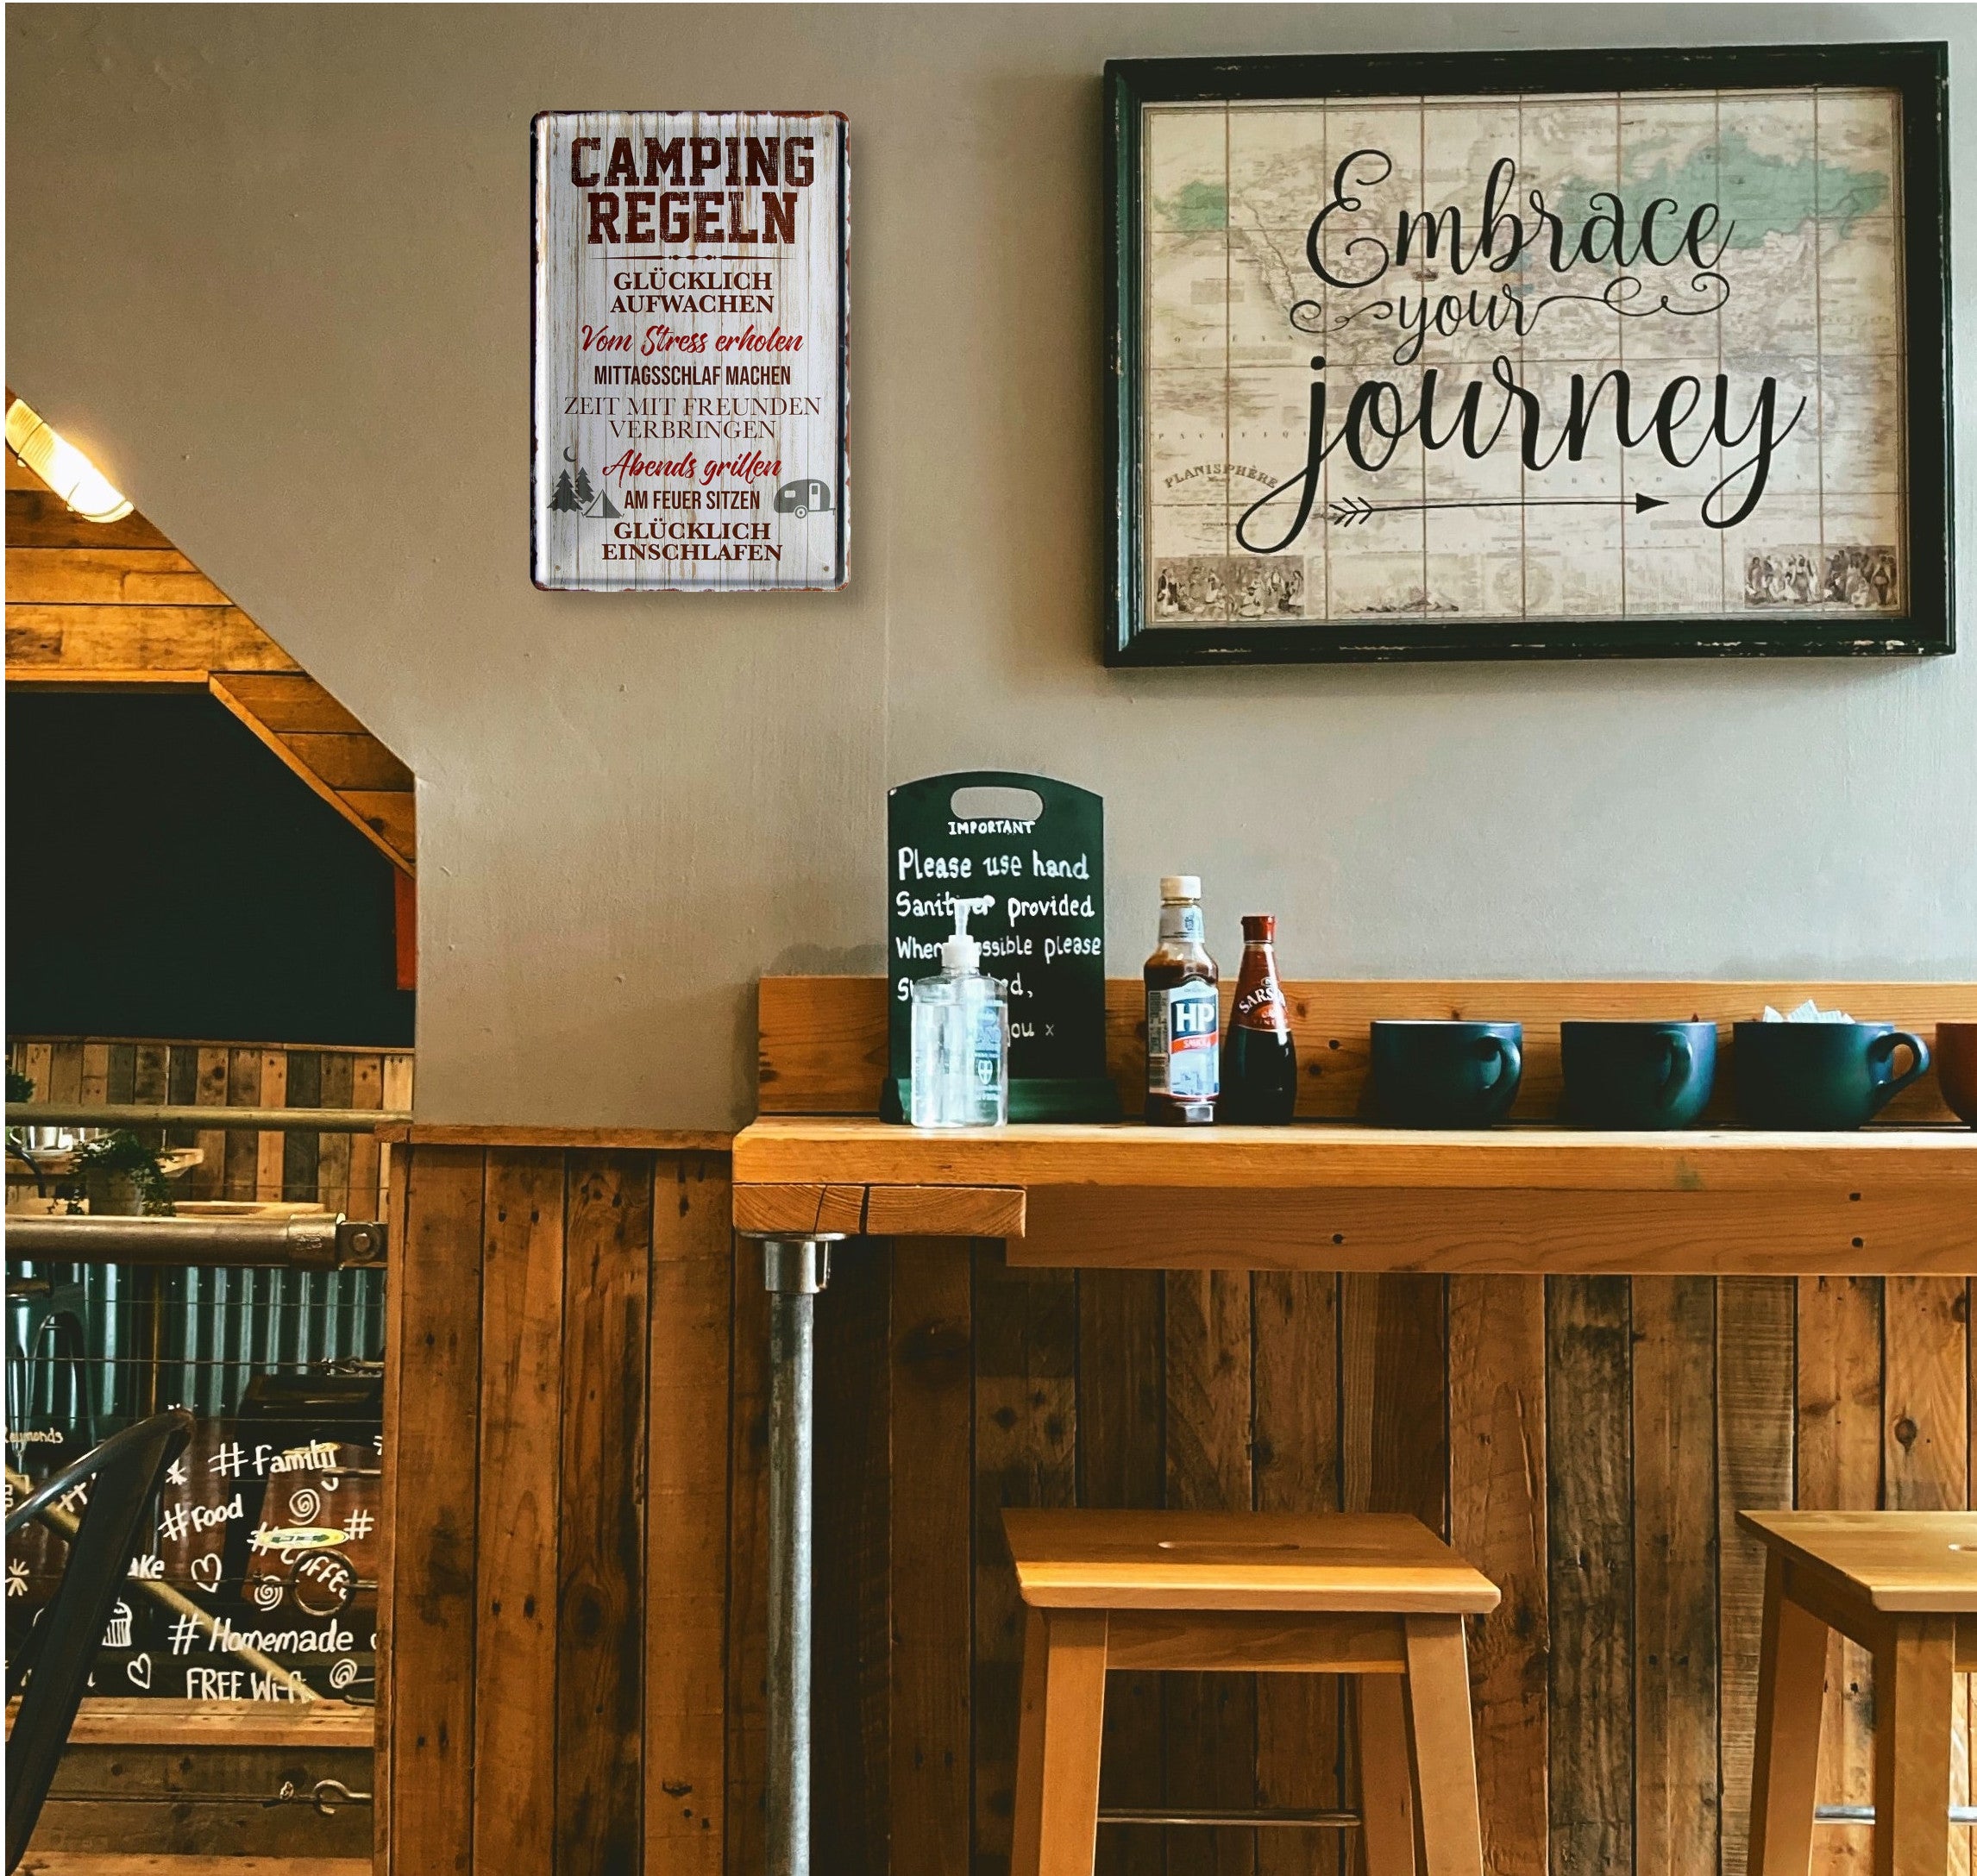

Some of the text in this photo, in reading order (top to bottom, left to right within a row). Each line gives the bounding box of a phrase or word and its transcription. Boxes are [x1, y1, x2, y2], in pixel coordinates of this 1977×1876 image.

[571, 136, 814, 187] CAMPING
[587, 191, 798, 244] REGELN
[1305, 148, 1736, 290] Embrace
[613, 267, 773, 291] GLÜCKLICH
[610, 294, 775, 314] AUFWACHEN
[581, 324, 805, 357] Vom Stress erholen
[594, 366, 791, 386] MITTAGSSCHLAF MACHEN
[564, 397, 822, 416] ZEIT MIT FREUNDEN
[609, 421, 777, 440] VERBRINGEN
[602, 449, 784, 488] Abends grillen
[1234, 354, 1808, 555] journey
[624, 491, 760, 510] AM FEUER SITZEN
[613, 518, 771, 540] GLÜCKLICH
[601, 543, 783, 562] EINSCHLAFEN
[948, 819, 1035, 835] IMPORTANT
[897, 846, 1090, 881] Please use hand
[1007, 894, 1095, 927] provided
[1045, 936, 1101, 964] please
[1176, 1003, 1215, 1032] HP
[186, 1667, 245, 1702] FREE
